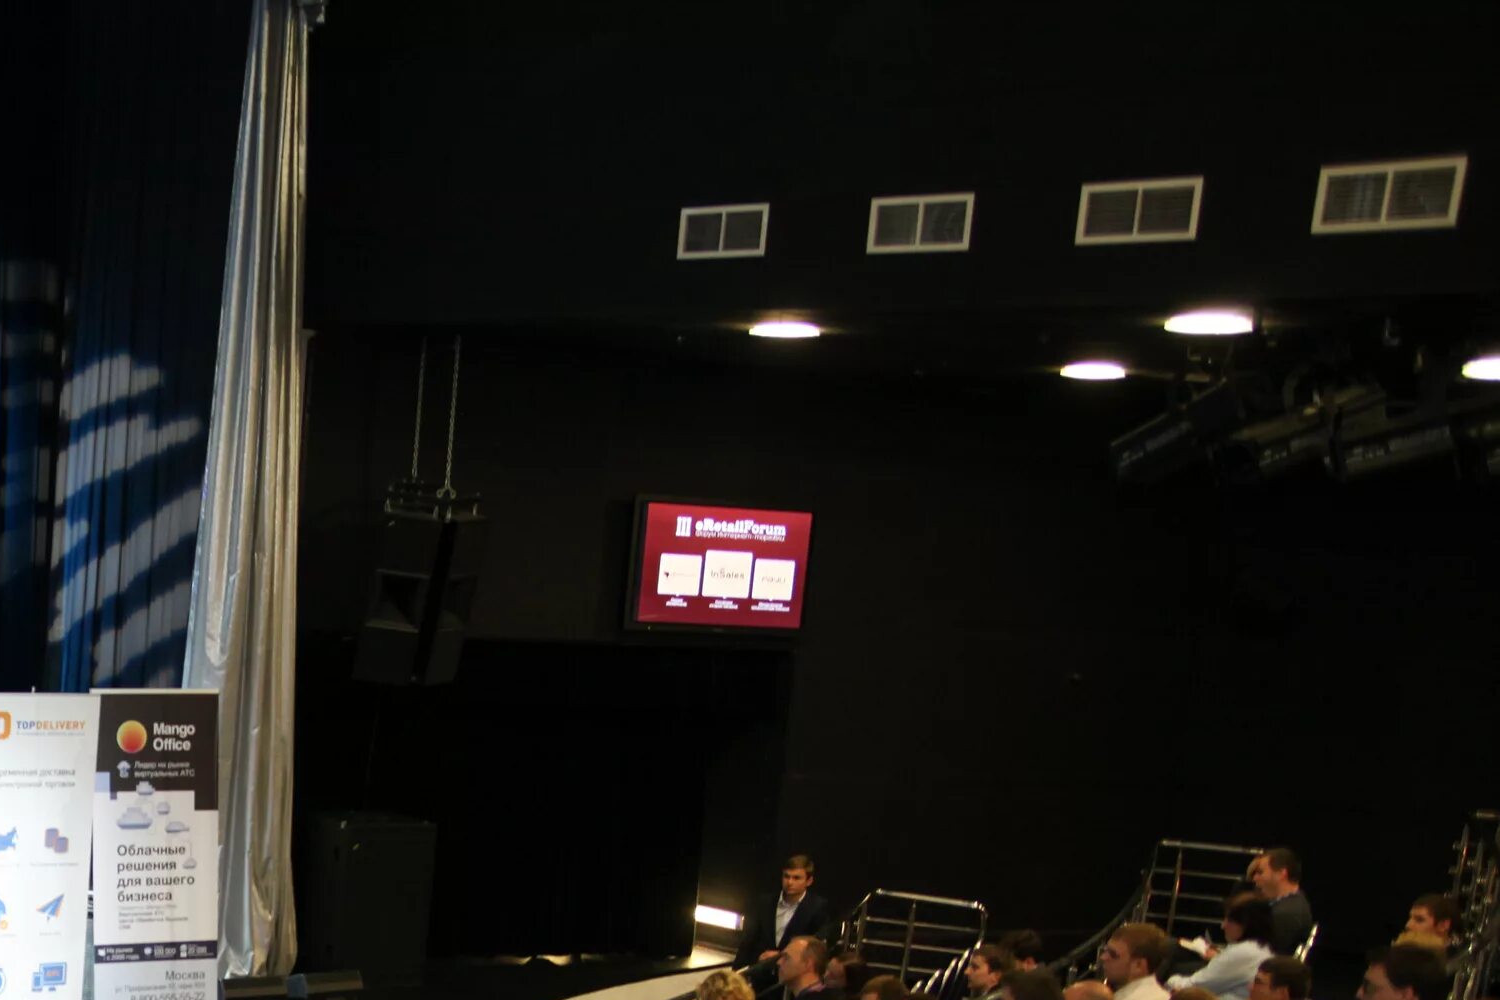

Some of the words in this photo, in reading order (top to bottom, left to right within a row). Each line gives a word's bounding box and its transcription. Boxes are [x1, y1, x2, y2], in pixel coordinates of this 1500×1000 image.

[695, 518, 786, 536] eRetailForum
[16, 721, 86, 730] TOPDELIVERY
[153, 722, 196, 738] Mango
[153, 738, 191, 751] Office
[39, 768, 76, 776] доставка
[117, 844, 186, 857] Облачные
[117, 861, 177, 874] решения
[117, 876, 142, 889] для
[146, 876, 195, 887] вашего
[117, 890, 173, 902] бизнеса
[165, 970, 205, 980] Москва
